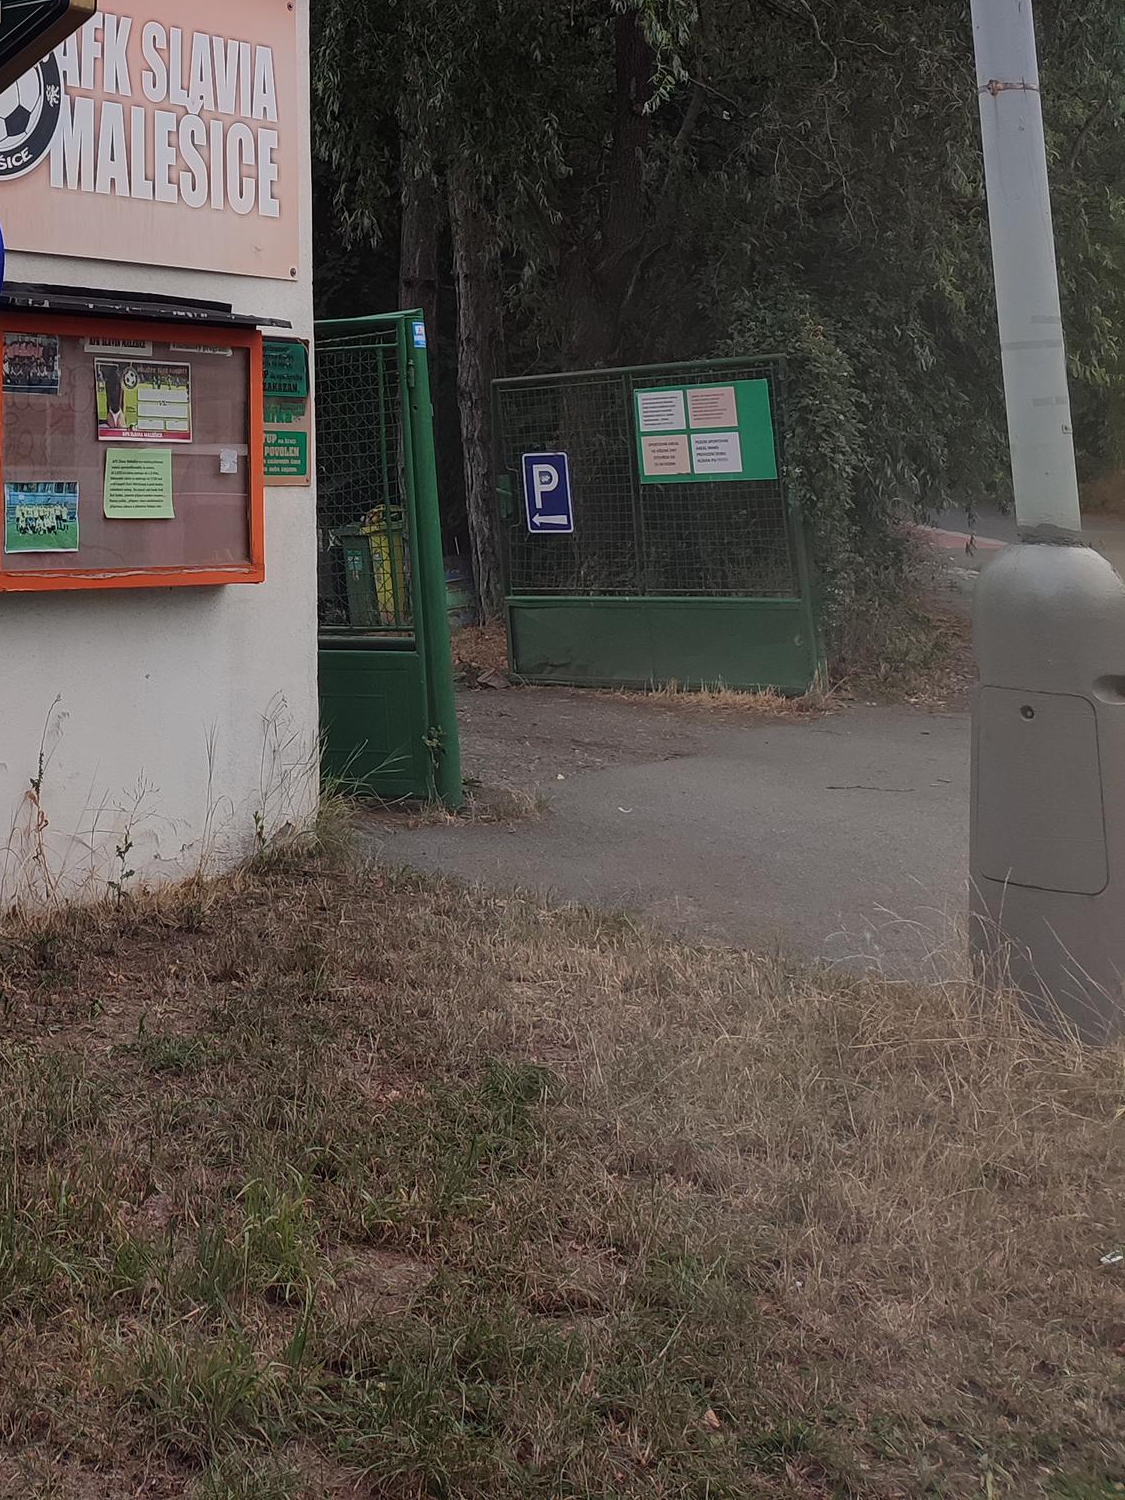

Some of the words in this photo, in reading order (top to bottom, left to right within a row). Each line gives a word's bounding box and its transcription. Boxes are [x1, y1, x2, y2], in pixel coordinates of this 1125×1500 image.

[59, 11, 132, 97] AFK
[141, 21, 278, 123] SLAVIA
[50, 96, 279, 218] MALEŠICE
[532, 464, 559, 509] P
